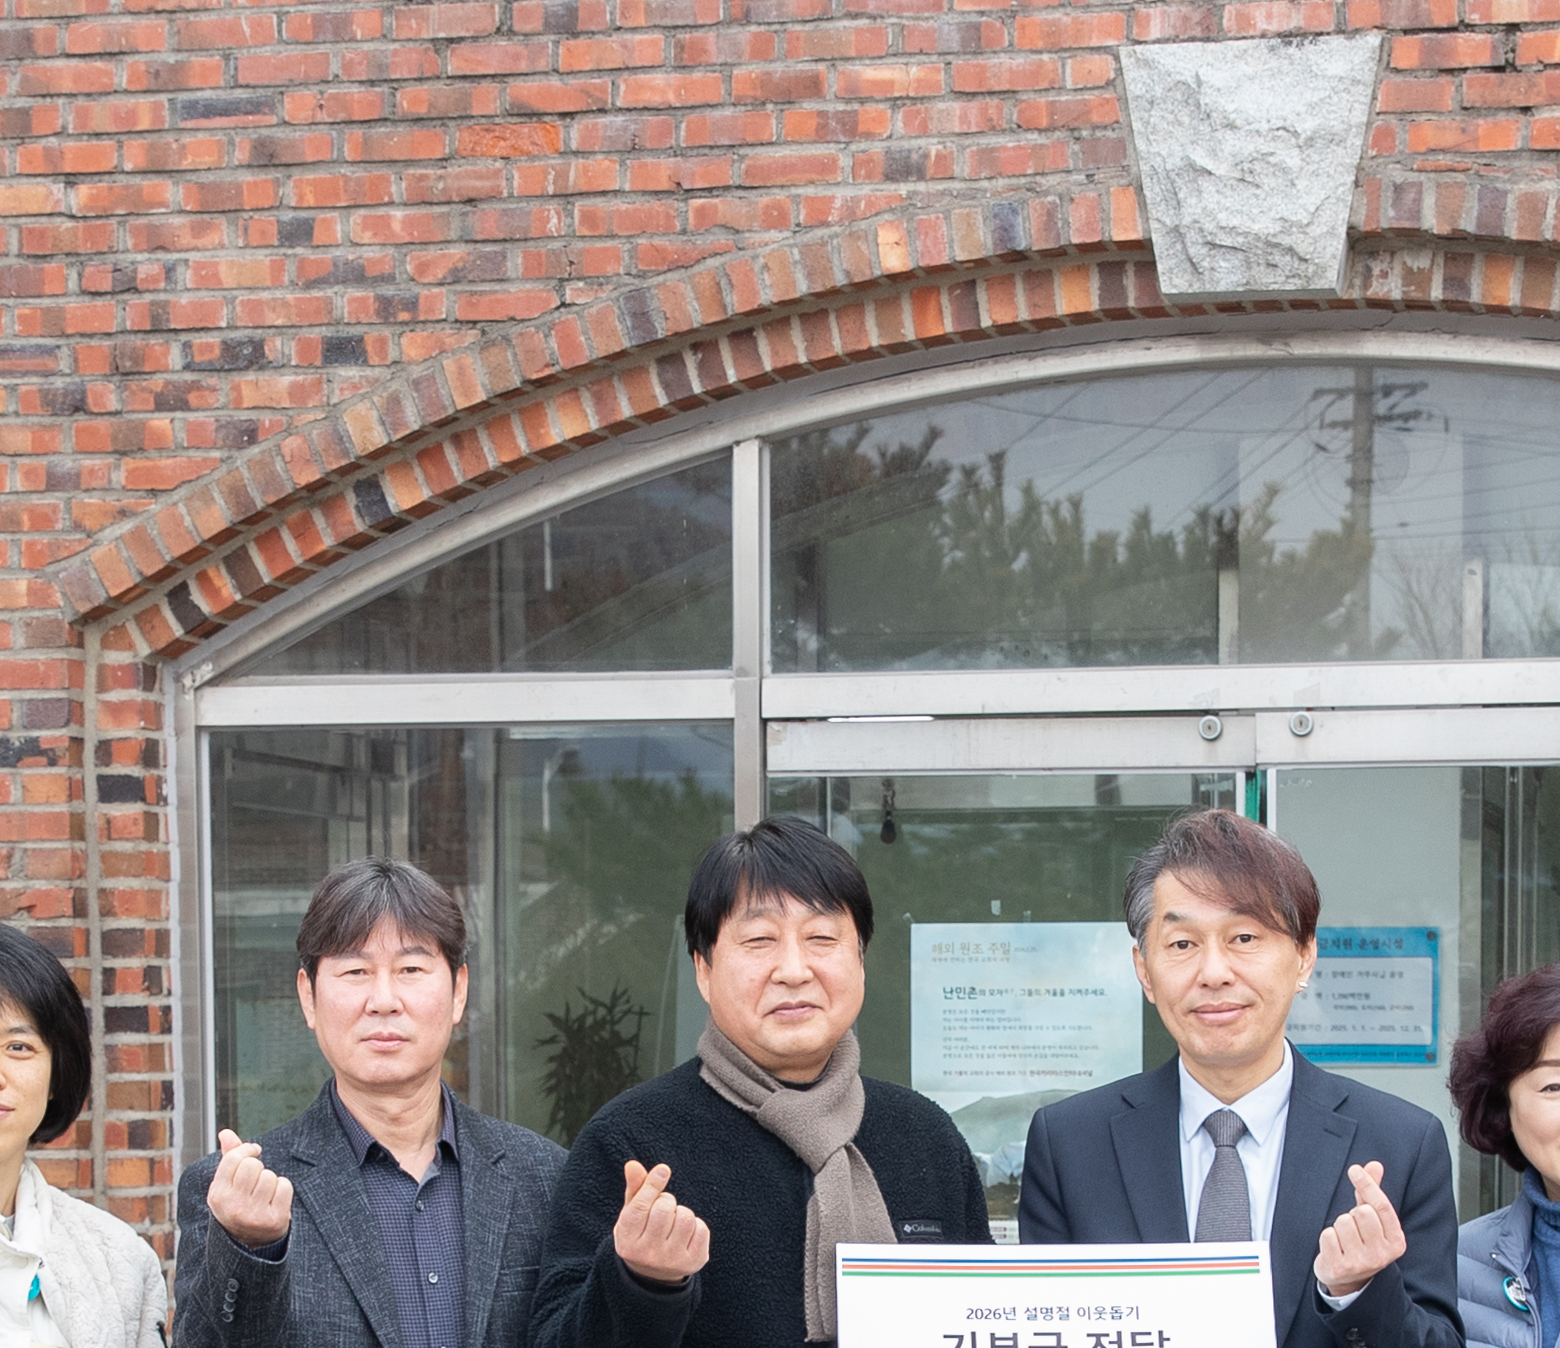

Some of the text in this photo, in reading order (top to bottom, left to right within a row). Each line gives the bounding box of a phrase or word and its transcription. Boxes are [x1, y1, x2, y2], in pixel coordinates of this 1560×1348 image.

[959, 941, 985, 956] 원조
[988, 941, 1011, 956] 주일
[965, 1304, 1141, 1321] 2026년 설명절 이웃돕기
